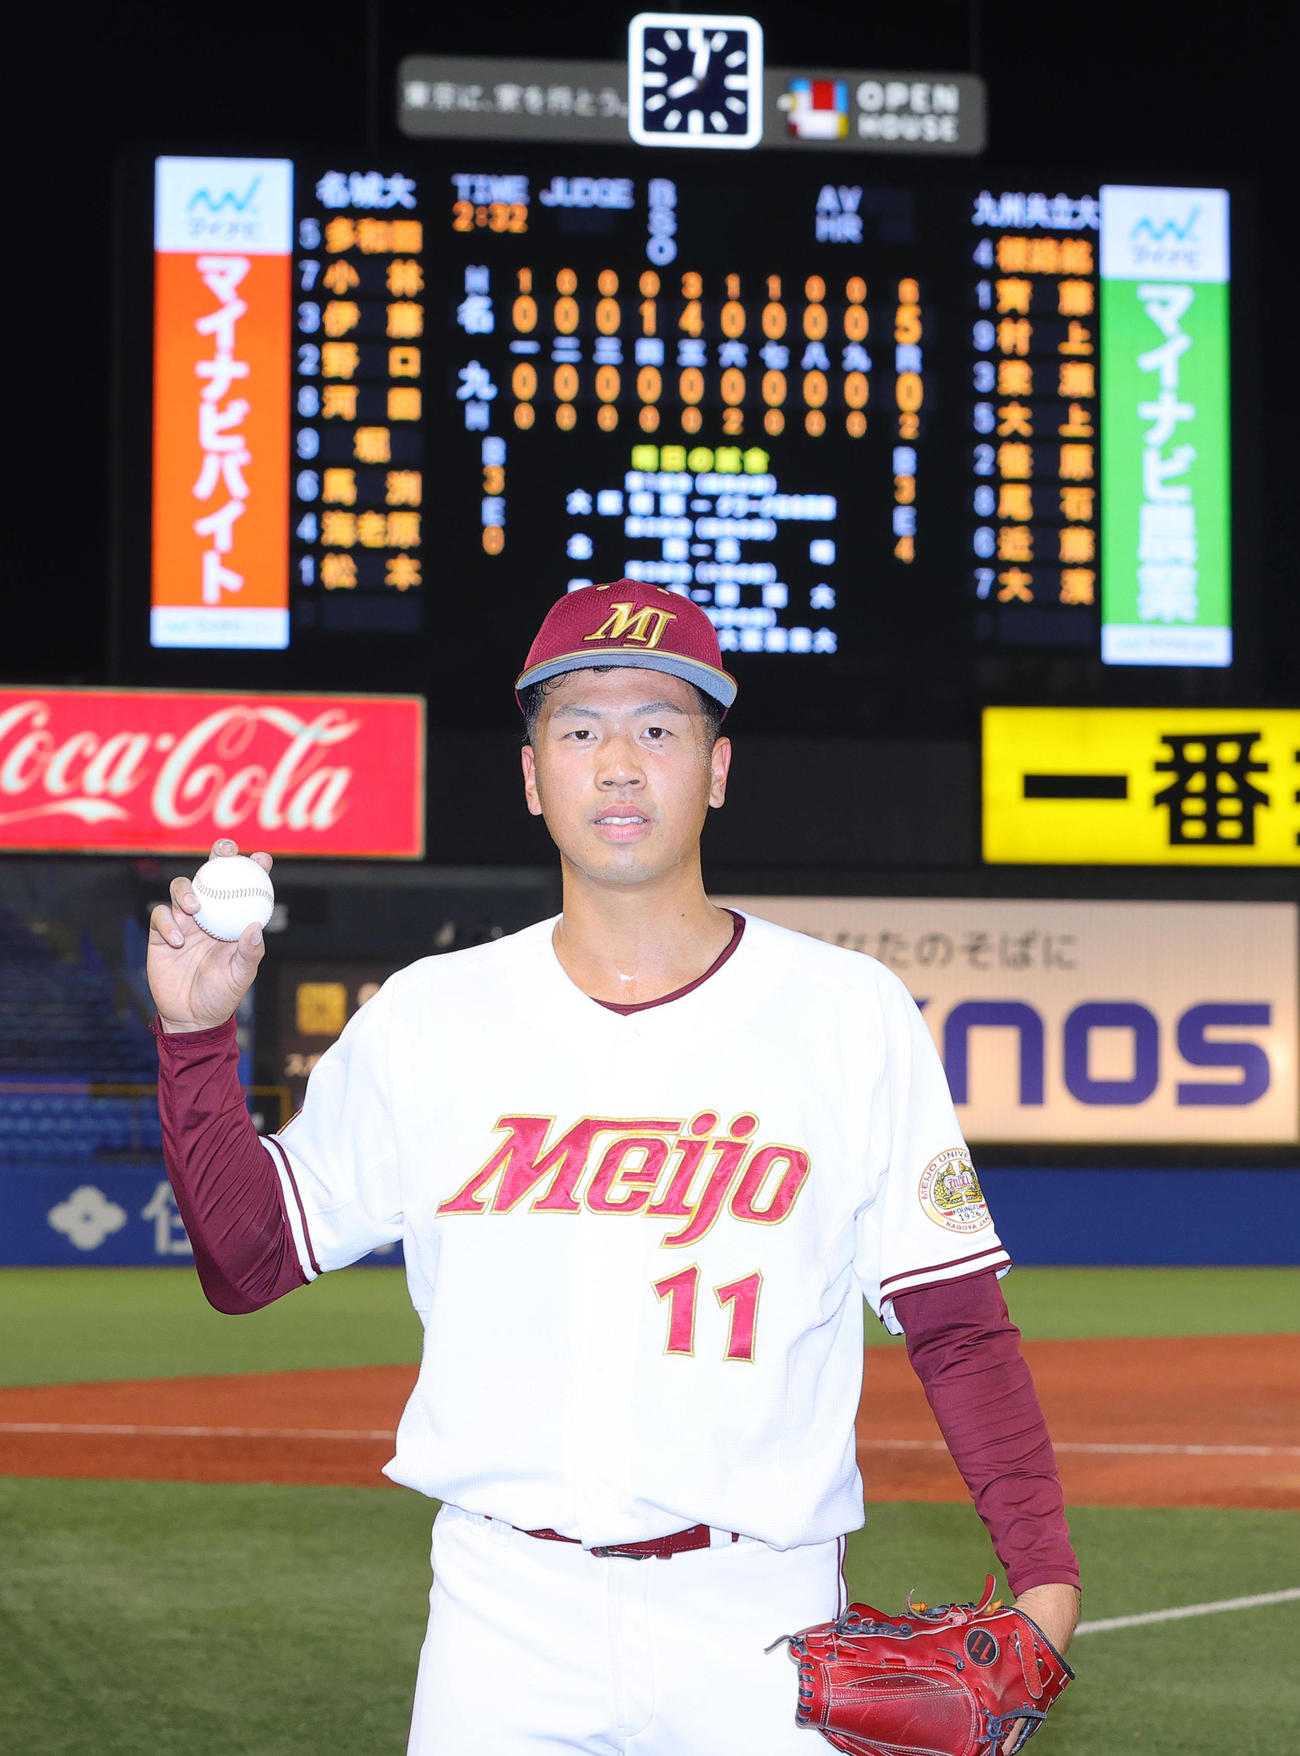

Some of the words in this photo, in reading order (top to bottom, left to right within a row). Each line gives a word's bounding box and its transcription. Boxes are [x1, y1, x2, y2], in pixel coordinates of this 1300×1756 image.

[856, 80, 960, 114] OPEN
[857, 112, 960, 143] HOUSE
[315, 170, 418, 210] 名城大
[450, 172, 530, 206] TIME
[538, 175, 636, 210] JUDGE
[815, 185, 864, 213] AV
[452, 200, 529, 233] 2:32
[971, 190, 1100, 230] 九州共立大
[299, 217, 322, 251] 5
[815, 213, 864, 244] HR
[972, 239, 995, 270] 4
[299, 259, 321, 291] 7
[518, 268, 532, 294] 1
[556, 268, 578, 296] 0
[597, 269, 619, 297] 0
[639, 270, 661, 298] 0
[681, 271, 703, 300] 3
[726, 273, 740, 299] 1
[767, 274, 781, 300] 1
[804, 275, 827, 304] 0
[845, 276, 868, 305] 0
[974, 279, 992, 311] 1
[299, 301, 322, 334] 3
[512, 294, 538, 333] 0
[553, 296, 579, 334] 0
[595, 296, 621, 335] 0
[639, 299, 657, 336] 1
[678, 299, 704, 337] 4
[720, 300, 746, 339] 0
[761, 301, 787, 340] 0
[803, 303, 828, 341] 0
[844, 304, 869, 342] 0
[894, 303, 923, 345] 5
[972, 319, 996, 353] 9
[996, 317, 1094, 356] 村上
[299, 343, 321, 377] 2
[456, 360, 498, 401] 九
[512, 363, 537, 401] 0
[554, 364, 579, 402] 0
[595, 365, 621, 403] 0
[637, 366, 662, 404] 0
[679, 367, 705, 405] 0
[720, 368, 746, 406] 0
[761, 369, 787, 407] 0
[803, 370, 828, 408] 0
[844, 371, 869, 409] 0
[895, 372, 924, 412] 0
[972, 360, 996, 394] 3
[299, 385, 321, 418] 8
[192, 255, 252, 605] マイナビバイト
[513, 402, 535, 429] 0
[555, 403, 577, 431] 0
[597, 404, 619, 431] 0
[638, 405, 660, 433] 0
[681, 406, 703, 434] 0
[722, 407, 744, 435] 2
[763, 408, 785, 436] 0
[804, 409, 826, 437] 0
[846, 410, 867, 438] 0
[898, 411, 920, 440] 2
[973, 401, 996, 435] 5
[997, 401, 1095, 438] 大上
[299, 427, 321, 460] 9
[973, 443, 996, 476] 2
[299, 469, 320, 503] 6
[482, 465, 506, 495] 3
[894, 475, 917, 505] 3
[973, 484, 996, 518] 8
[298, 512, 319, 543] 4
[892, 505, 918, 536] E
[893, 535, 916, 564] 4
[972, 526, 997, 559] 6
[299, 555, 316, 586] 1
[973, 567, 996, 600] 7
[583, 601, 677, 648] MJ
[1022, 731, 1300, 846] 一番
[435, 1109, 811, 1249] Meijo
[920, 1162, 938, 1200] MEIJO
[945, 1221, 978, 1231] NAGOYA
[959, 1211, 982, 1222] 1926
[650, 1262, 763, 1363] 11
